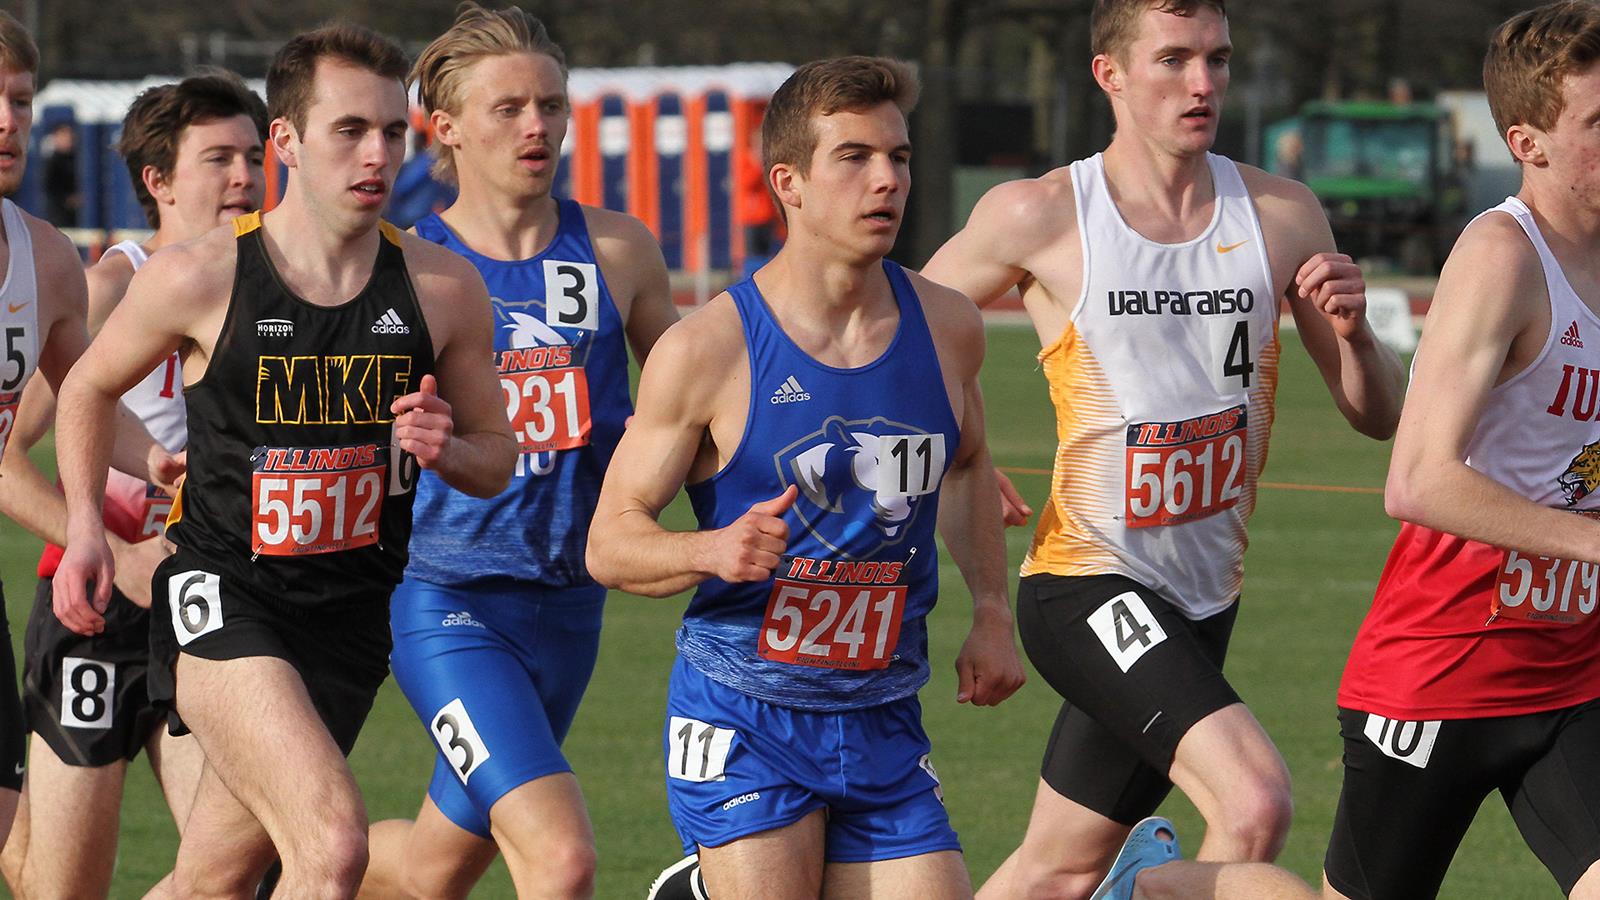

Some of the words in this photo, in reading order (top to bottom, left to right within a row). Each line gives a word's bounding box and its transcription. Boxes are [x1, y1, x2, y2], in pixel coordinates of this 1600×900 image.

[556, 265, 589, 325] 3
[257, 323, 294, 332] HORIZON
[371, 323, 410, 334] adidas
[1223, 320, 1255, 389] 4
[1560, 335, 1584, 349] adidas
[1, 327, 26, 391] 5
[256, 355, 412, 425] MKE
[770, 390, 811, 405] adidas
[1546, 363, 1600, 423] IU
[1137, 408, 1242, 445] ILLINOIS
[264, 444, 378, 471] ILLINOIS
[891, 438, 932, 494] 11
[1130, 435, 1243, 518] 5612
[257, 472, 381, 545] 5512
[787, 557, 904, 584] ILLINOIS
[178, 573, 211, 635] 6
[442, 615, 486, 630] adidas
[765, 586, 897, 660] 5241
[1112, 599, 1152, 653] 4
[70, 663, 109, 722] 8
[435, 713, 475, 776] 3
[677, 722, 717, 778] 11
[723, 791, 761, 811] adidas
